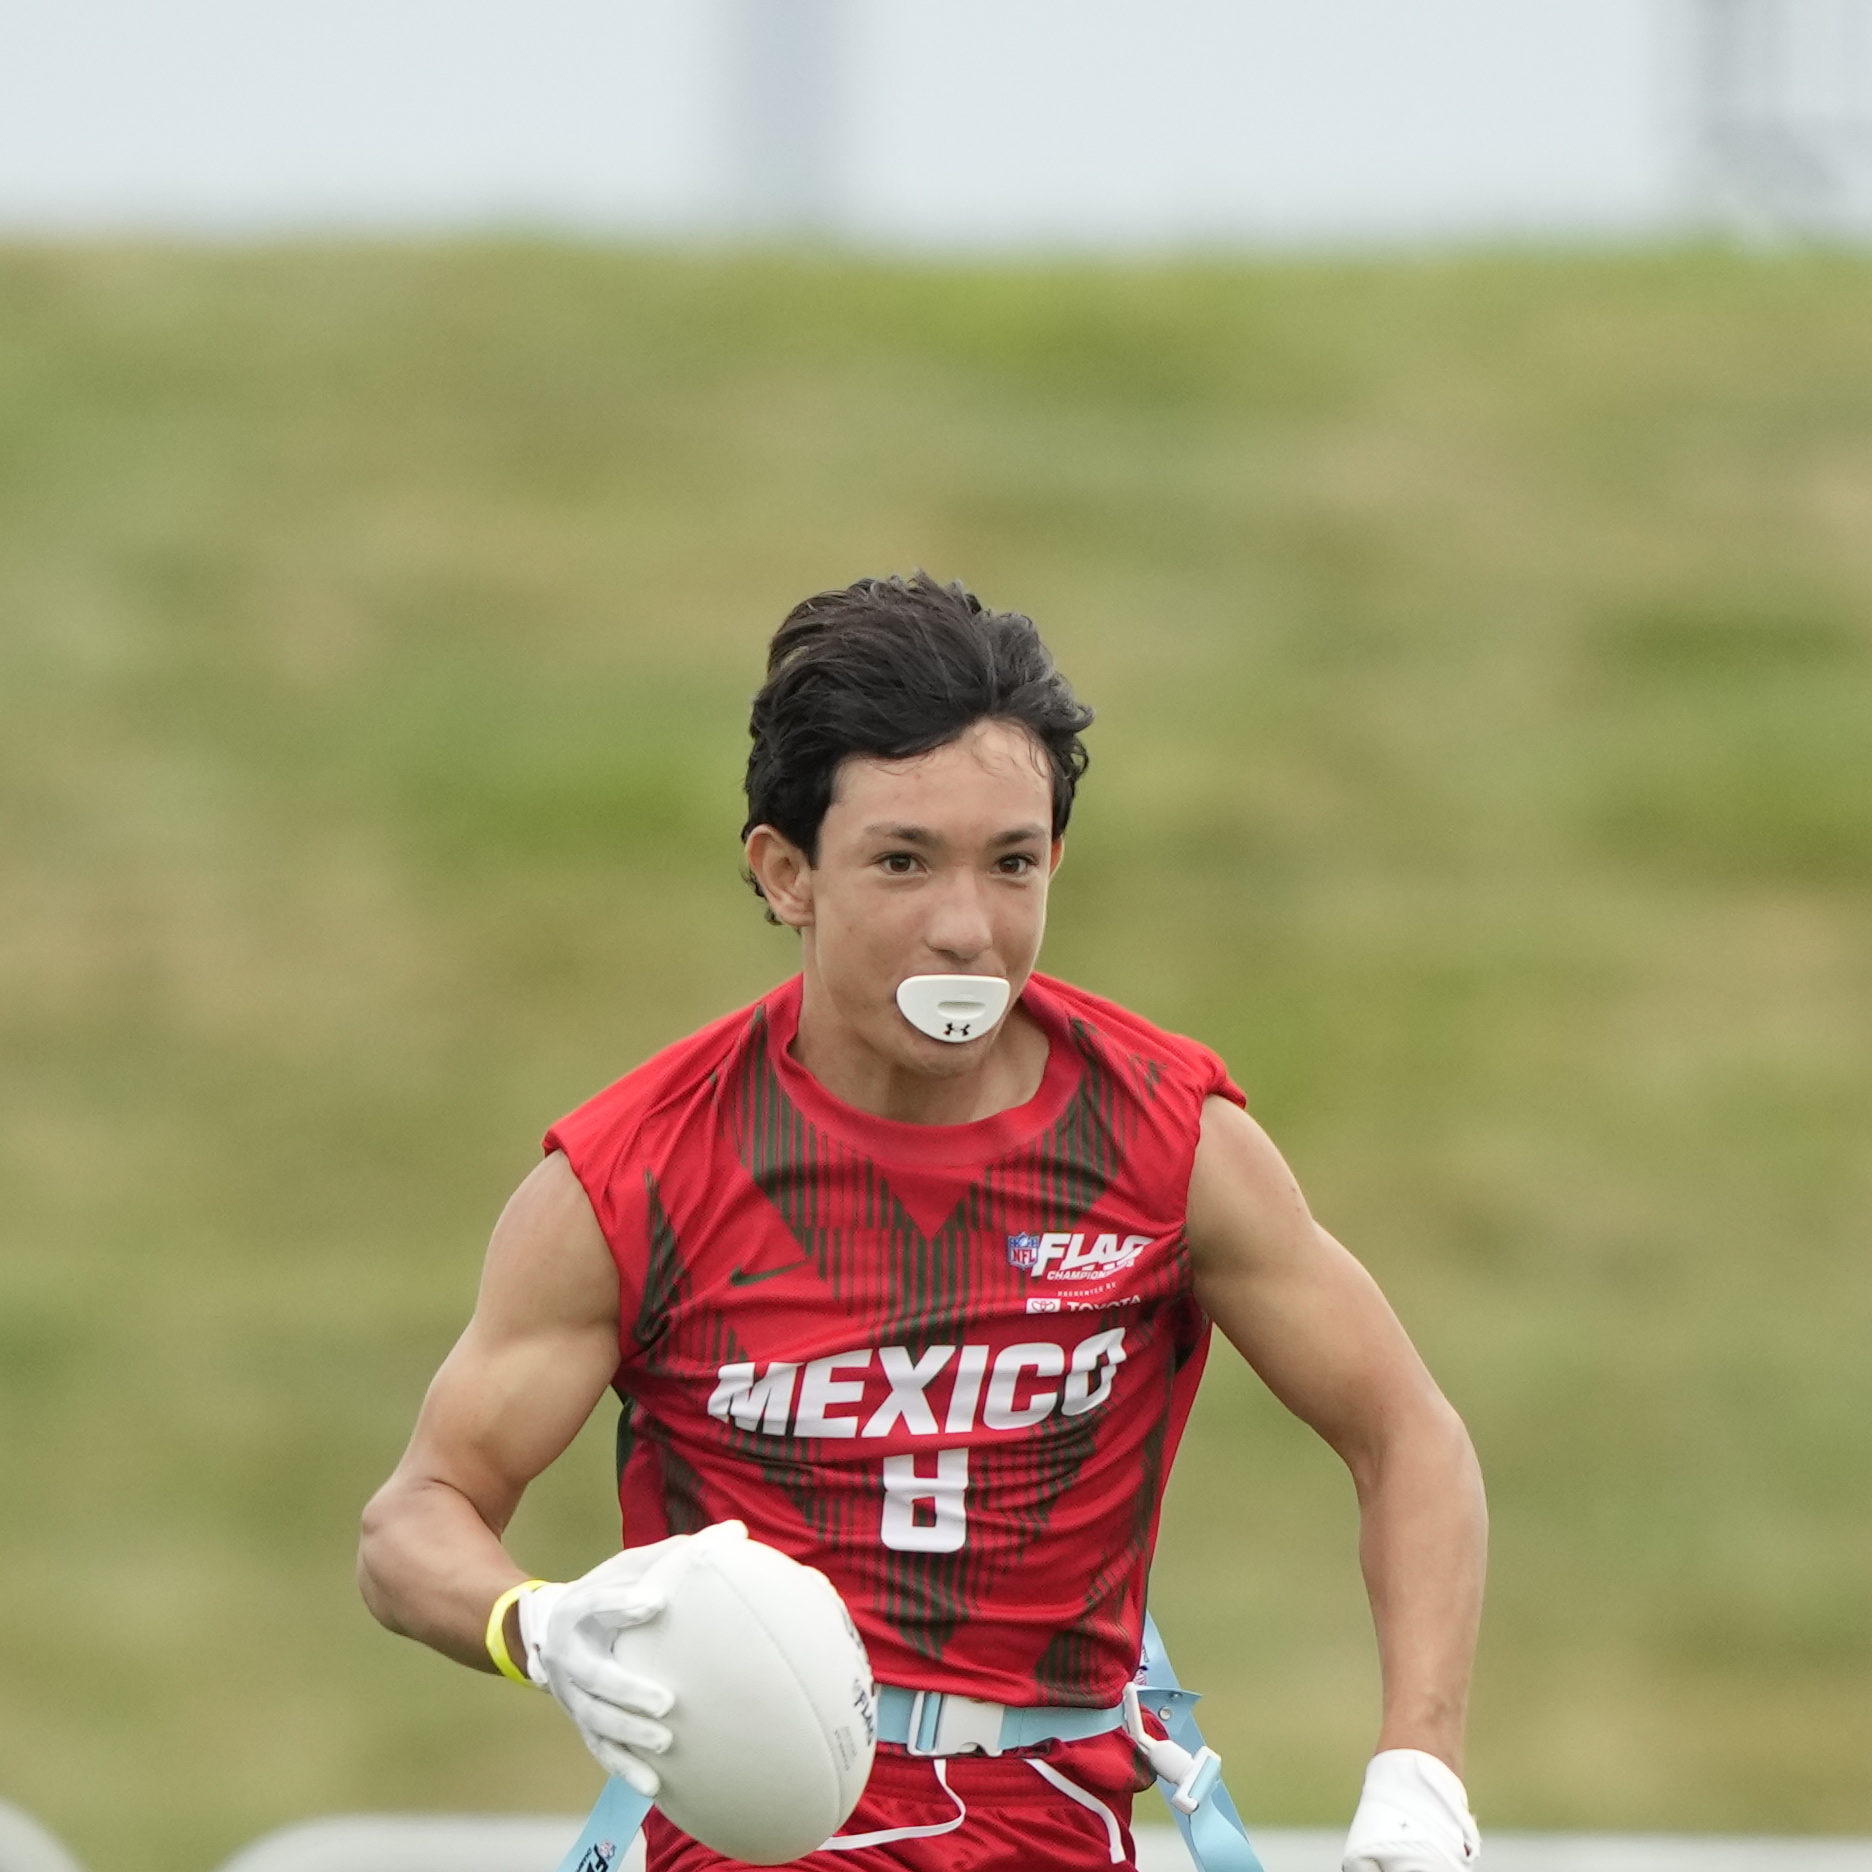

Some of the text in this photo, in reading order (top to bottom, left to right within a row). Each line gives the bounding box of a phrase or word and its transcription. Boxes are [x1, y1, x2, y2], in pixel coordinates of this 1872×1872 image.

[1031, 1233, 1155, 1277] FLAG
[707, 1327, 1127, 1439] MEXICO
[880, 1447, 969, 1553] 8
